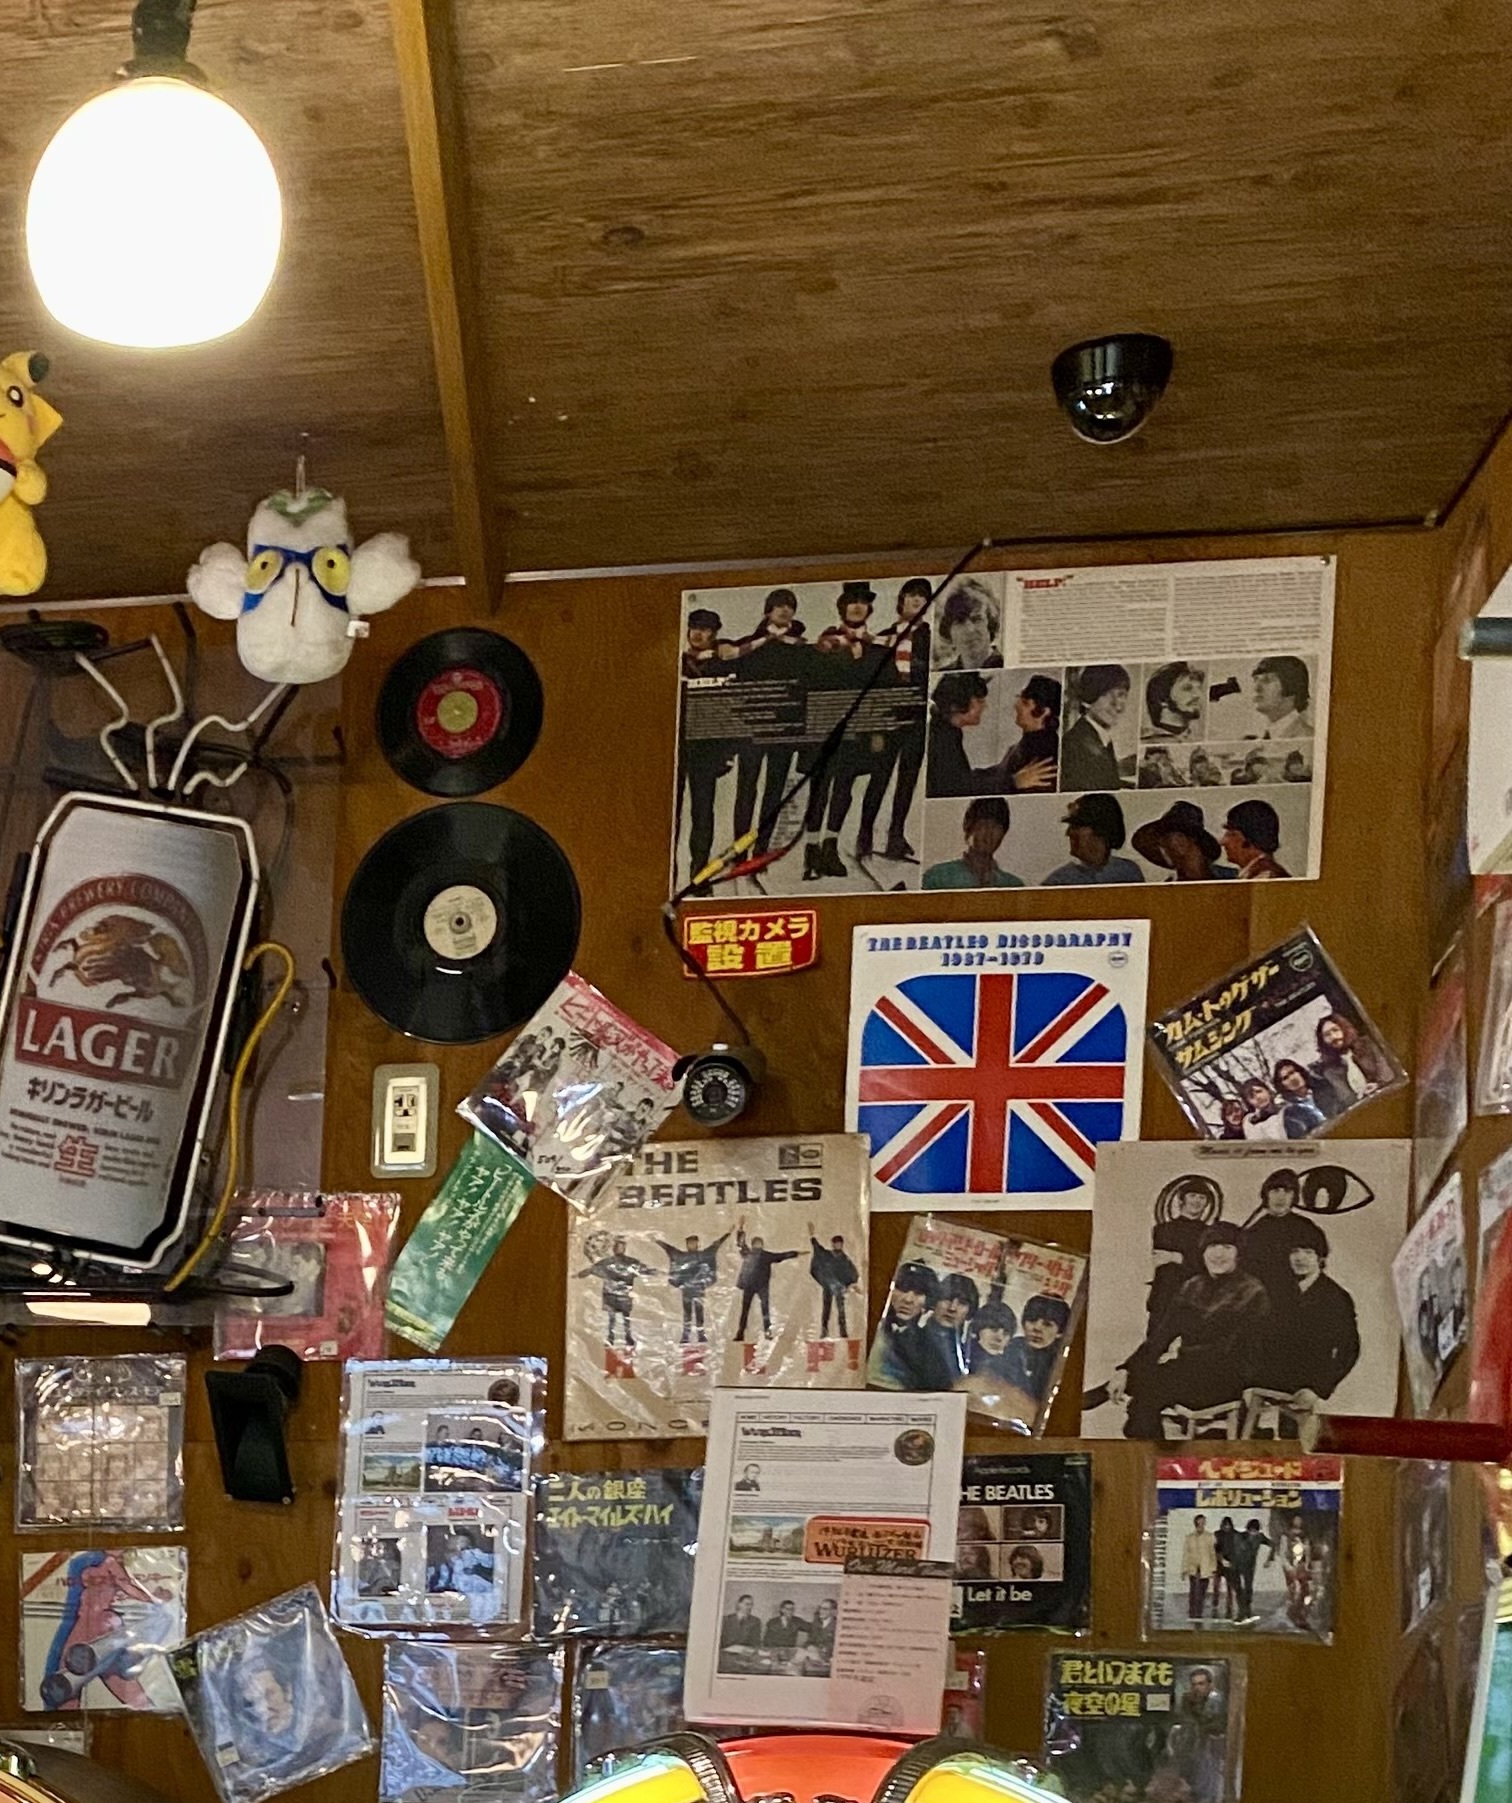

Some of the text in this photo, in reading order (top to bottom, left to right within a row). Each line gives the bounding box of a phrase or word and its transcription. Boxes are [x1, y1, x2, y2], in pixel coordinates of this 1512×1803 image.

[688, 917, 810, 944] 監視カメラ
[706, 940, 794, 971] 設置
[21, 1007, 183, 1080] LAGER
[1175, 1005, 1258, 1070] サムシング
[27, 1076, 155, 1124] キリンラガービール
[616, 1178, 823, 1209] BEATLES
[547, 1476, 648, 1502] 二人の銀座
[959, 1484, 1055, 1502] HE BEATLES
[1196, 1488, 1303, 1508] レボリューション
[967, 1585, 1033, 1602] Let it be
[1059, 1660, 1173, 1686] 君といつまでも
[1062, 1692, 1141, 1717] 夜空の星
